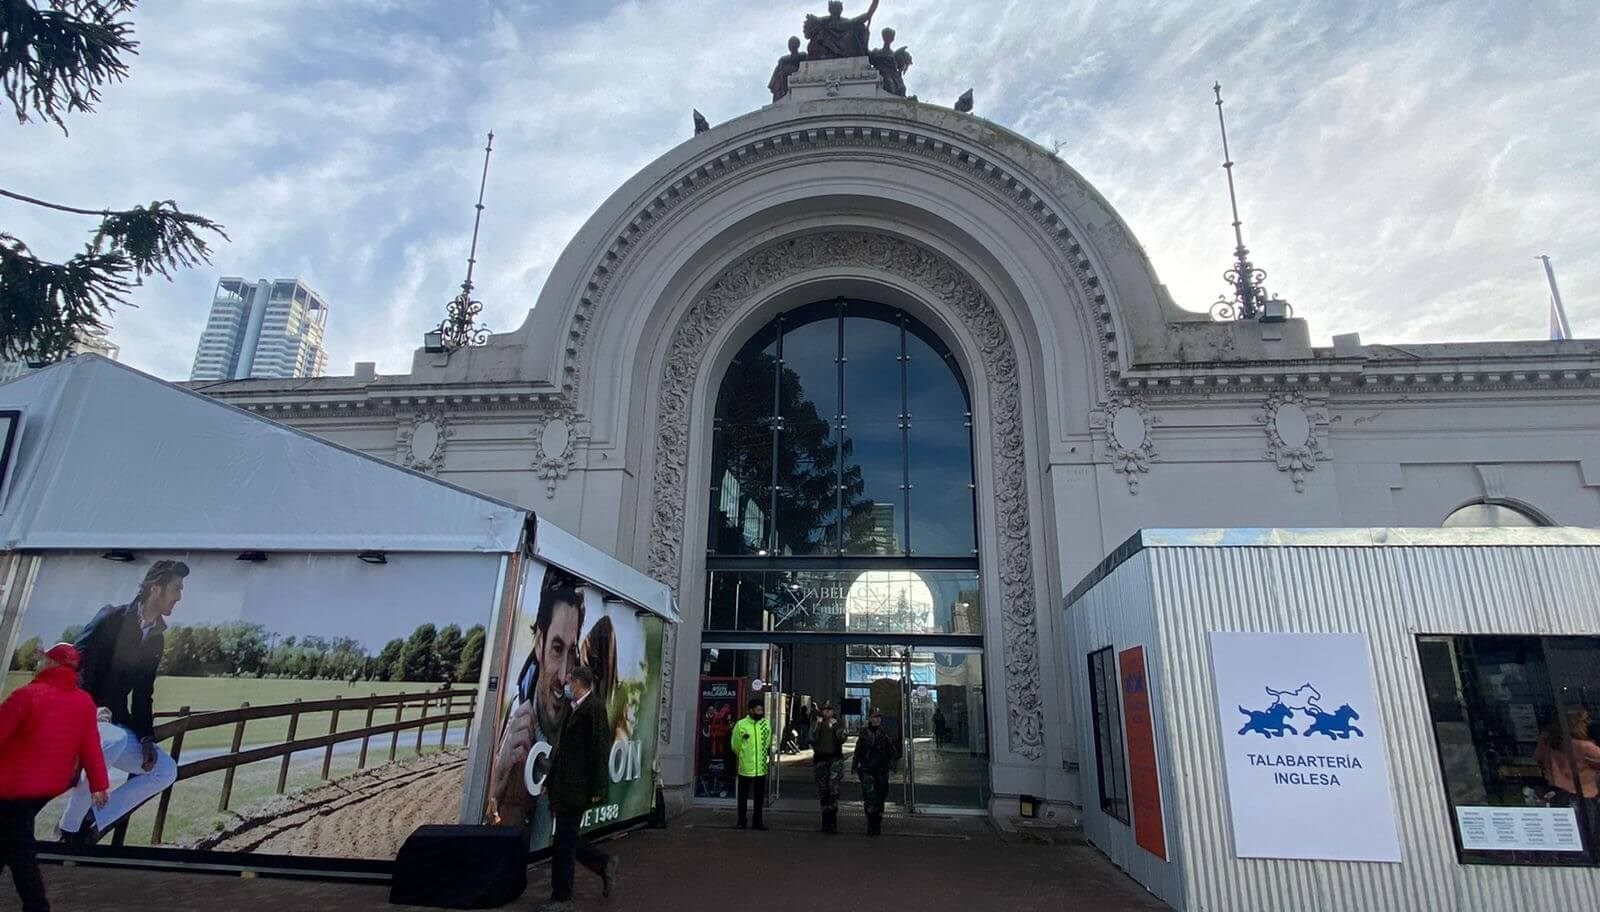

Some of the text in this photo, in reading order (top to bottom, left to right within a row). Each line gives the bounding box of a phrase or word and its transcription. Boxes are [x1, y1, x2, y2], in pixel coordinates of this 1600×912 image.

[1246, 753, 1363, 769] TALABARTERÍA
[1274, 772, 1341, 786] INGLESA
[595, 803, 619, 824] 1988
